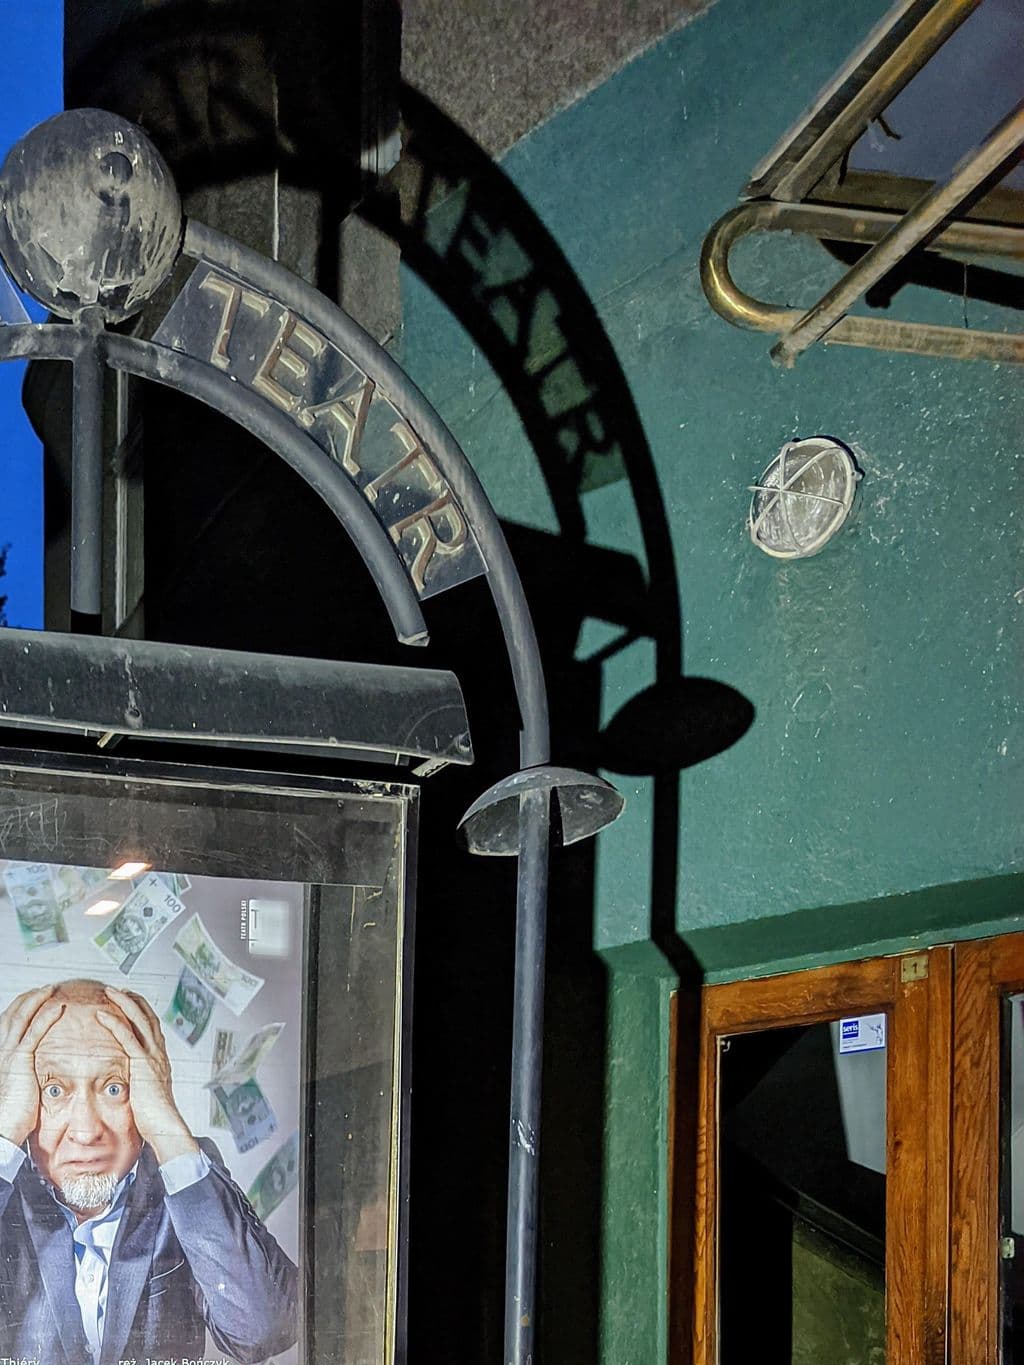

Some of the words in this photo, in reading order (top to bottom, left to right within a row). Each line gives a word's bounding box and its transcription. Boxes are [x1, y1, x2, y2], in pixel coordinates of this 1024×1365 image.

[197, 271, 470, 598] TEATR
[164, 895, 182, 913] 100
[912, 962, 918, 973] 1
